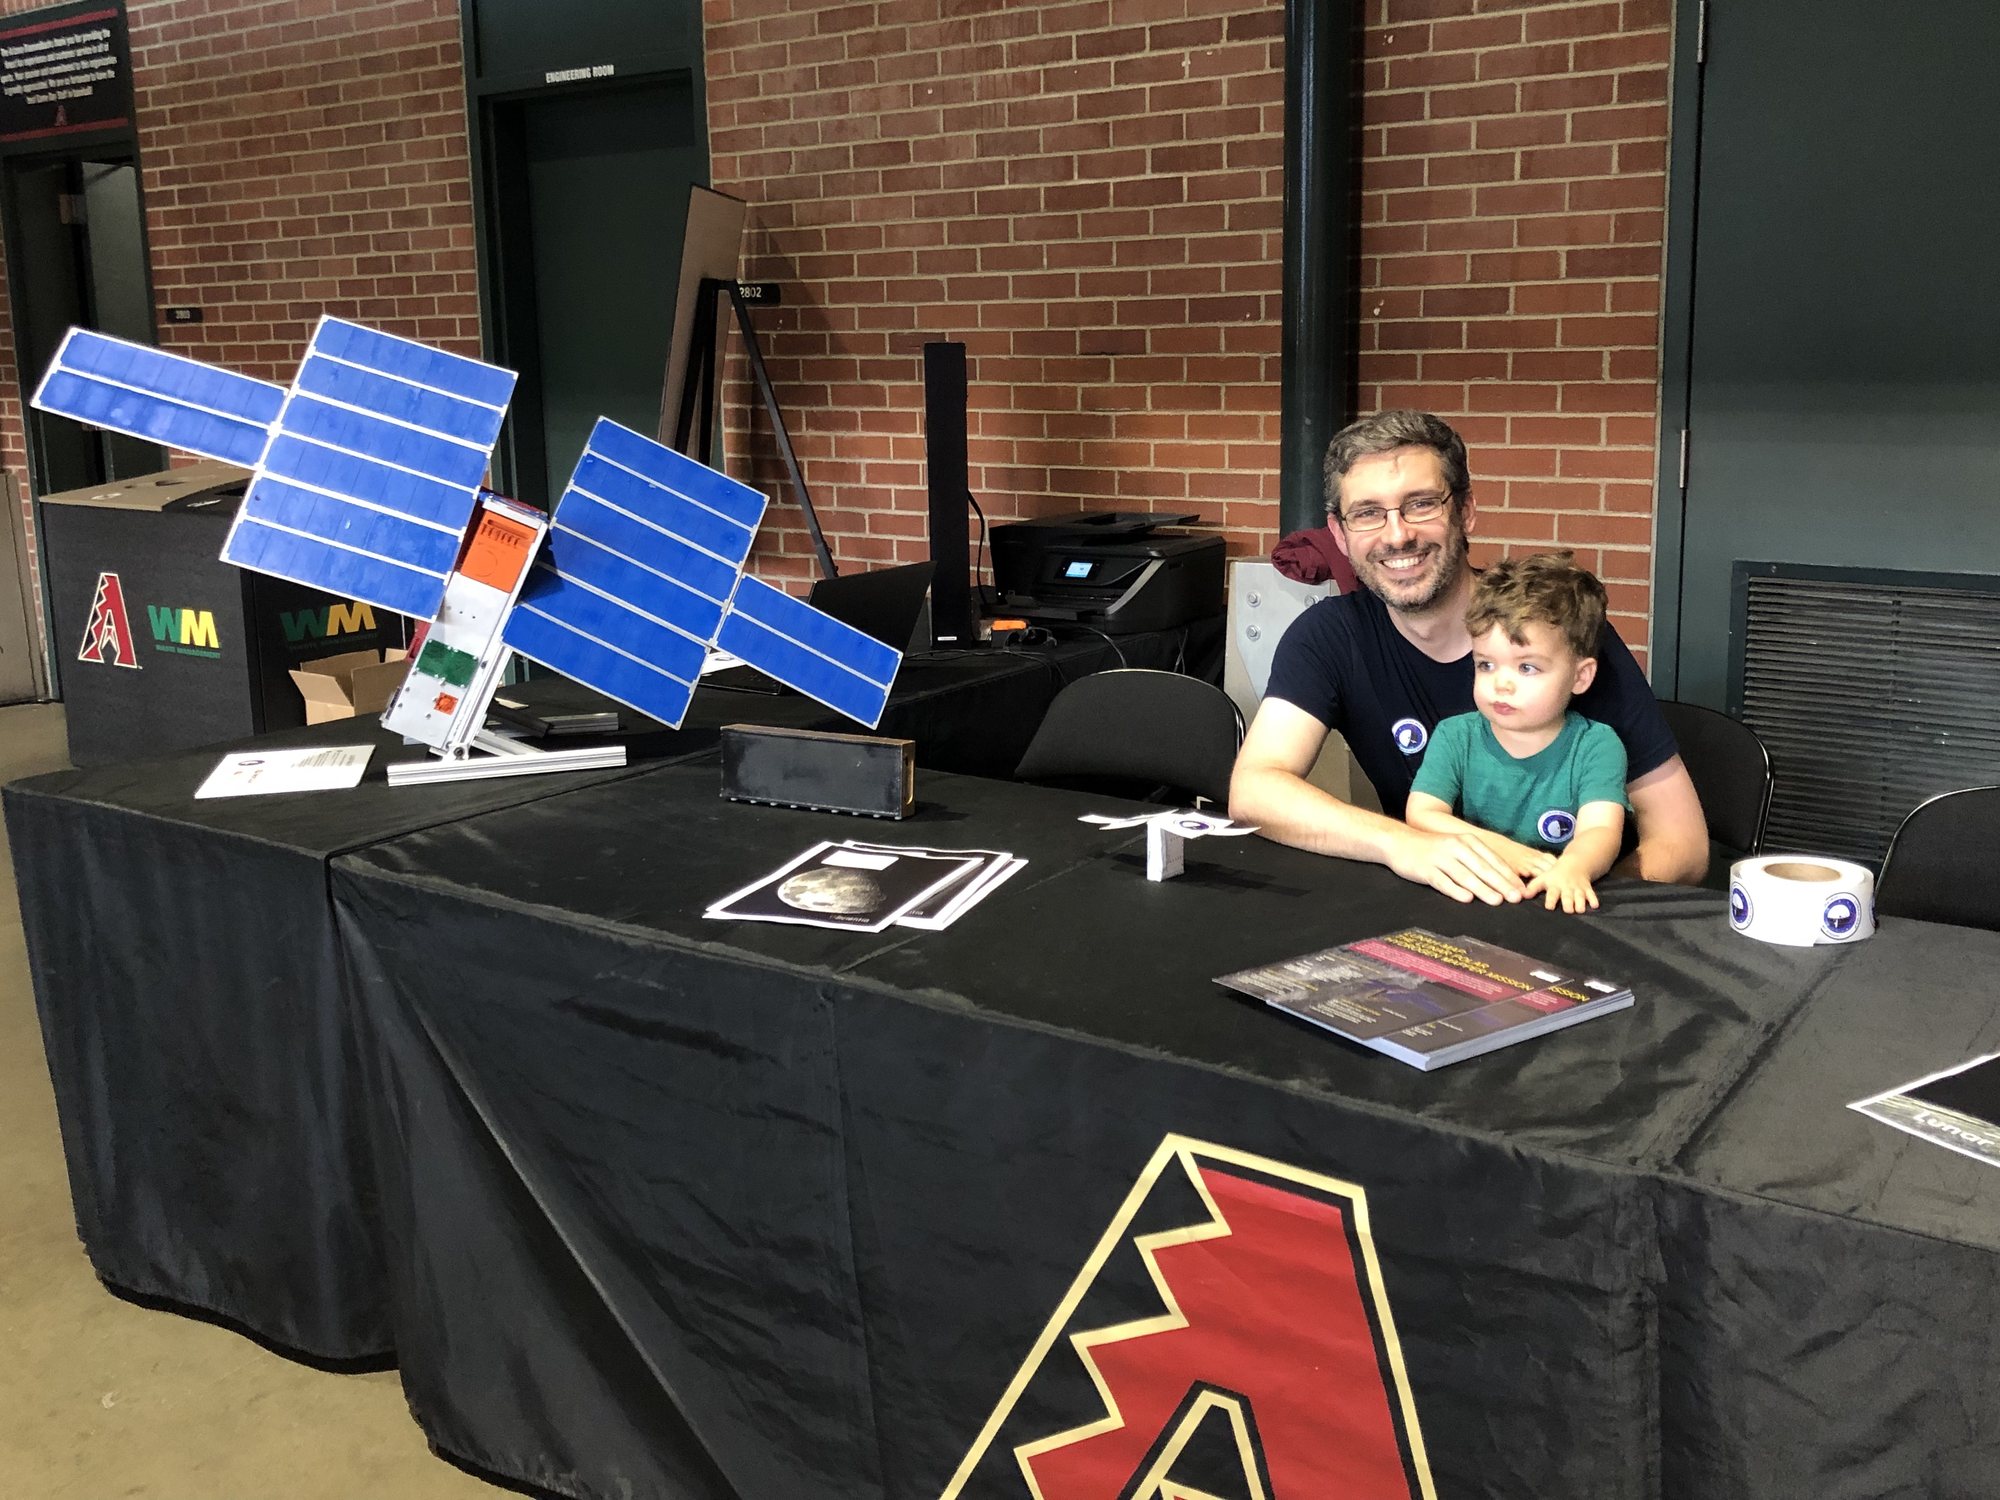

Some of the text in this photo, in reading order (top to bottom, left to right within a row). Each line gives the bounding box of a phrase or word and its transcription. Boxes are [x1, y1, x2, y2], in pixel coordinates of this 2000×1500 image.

[545, 64, 615, 84] ENGINEERING ROOM
[739, 286, 762, 298] 2802
[147, 604, 220, 649] WM
[280, 601, 377, 642] WM
[1912, 1109, 1996, 1146] Lunar
